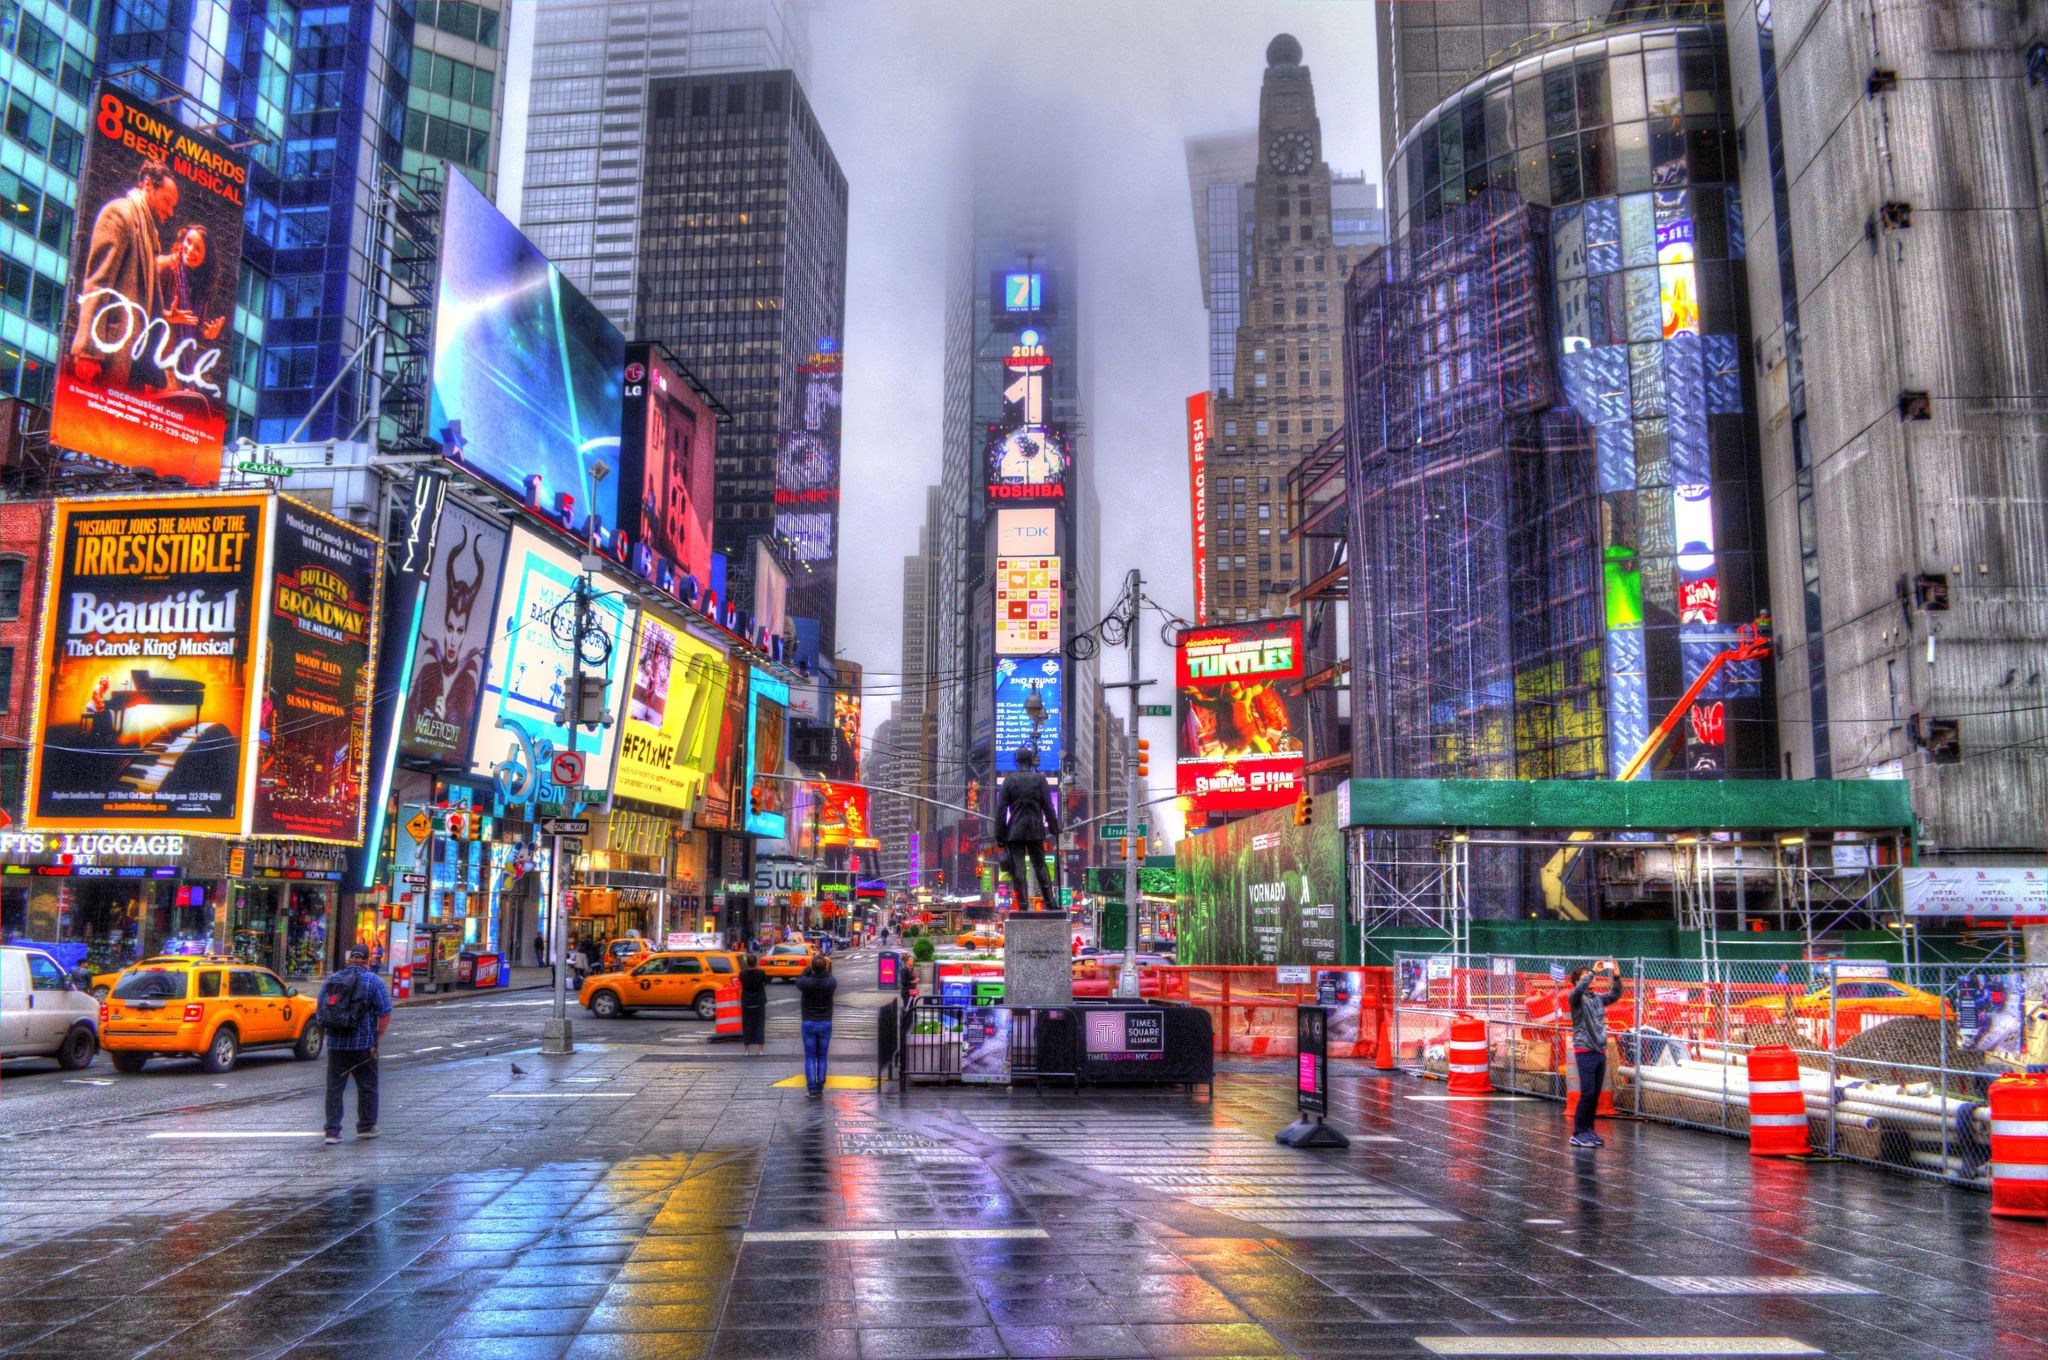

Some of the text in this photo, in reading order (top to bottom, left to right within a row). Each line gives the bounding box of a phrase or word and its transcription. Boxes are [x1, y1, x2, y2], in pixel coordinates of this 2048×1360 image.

[97, 94, 246, 185] 8 TONY AWARDS
[123, 130, 243, 207] BEST MUSICAL
[1004, 355, 1052, 367] TOSHIBA
[1012, 345, 1044, 357] 2014
[625, 385, 642, 397] LG
[1193, 418, 1204, 462] FRSH
[241, 462, 289, 477] LAMAR
[988, 484, 1065, 498] TOSHIBA
[128, 518, 157, 534] JOINS
[158, 518, 175, 533] THE
[177, 516, 211, 533] RANKS
[213, 516, 225, 532] OF
[225, 515, 246, 531] THE
[286, 513, 314, 535] Musical
[315, 527, 345, 550] Comedy
[1014, 527, 1049, 537] TDK
[300, 569, 348, 602] BULLETS
[314, 587, 333, 602] OVER
[69, 588, 239, 635] Beautiful
[279, 586, 364, 634] BROADWAY
[67, 637, 235, 660] The Carole King Musical
[1186, 648, 1293, 678] TURTLES
[622, 732, 674, 770] #F21xME
[553, 822, 585, 831] ONE WAY
[605, 808, 671, 857] FOREVER
[63, 835, 184, 856] LUGGAGE
[73, 854, 95, 865] NY
[78, 867, 112, 876] SONY
[1248, 881, 1286, 905] VORNADO
[1128, 1028, 1160, 1037] SQUARE
[1131, 1019, 1157, 1027] TIMES
